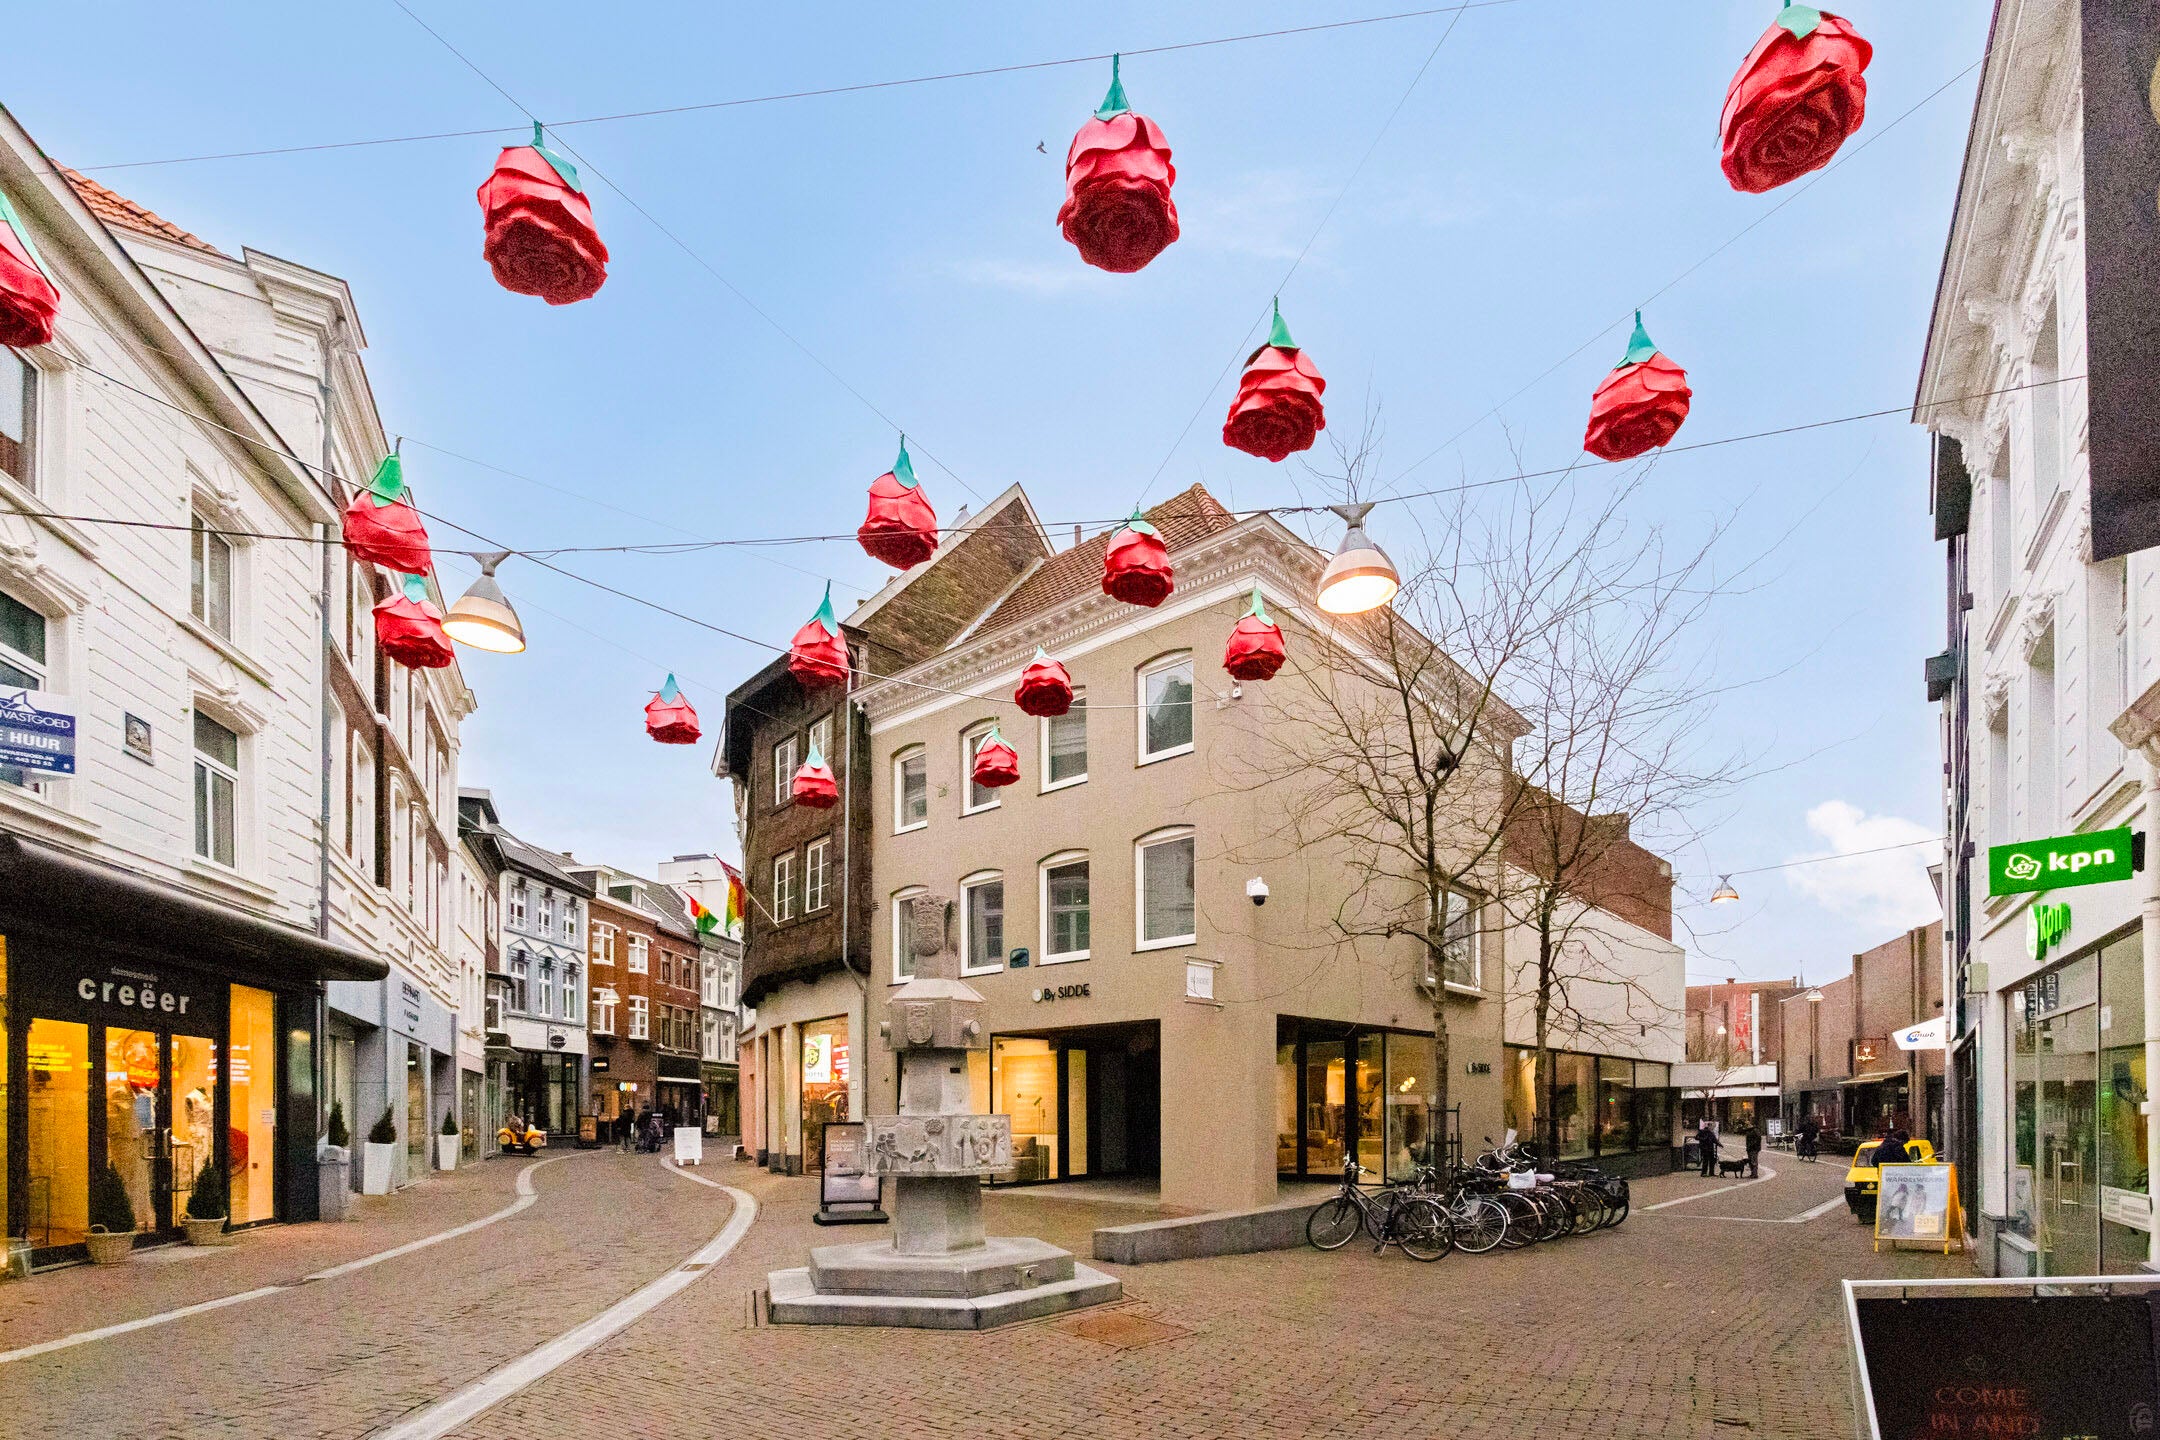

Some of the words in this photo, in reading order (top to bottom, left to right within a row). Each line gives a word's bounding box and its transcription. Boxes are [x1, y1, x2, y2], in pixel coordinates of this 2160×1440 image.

[0, 710, 70, 729] VASTGOED
[9, 731, 60, 751] HUUR
[2049, 848, 2115, 873] kpn
[2040, 904, 2062, 946] kpn
[78, 978, 190, 1014] creëer
[1044, 988, 1056, 1001] By
[1058, 984, 1090, 998] SIDDE
[1936, 1387, 2027, 1406] COME
[1931, 1413, 1960, 1431] IN
[1973, 1414, 2040, 1433] AND
